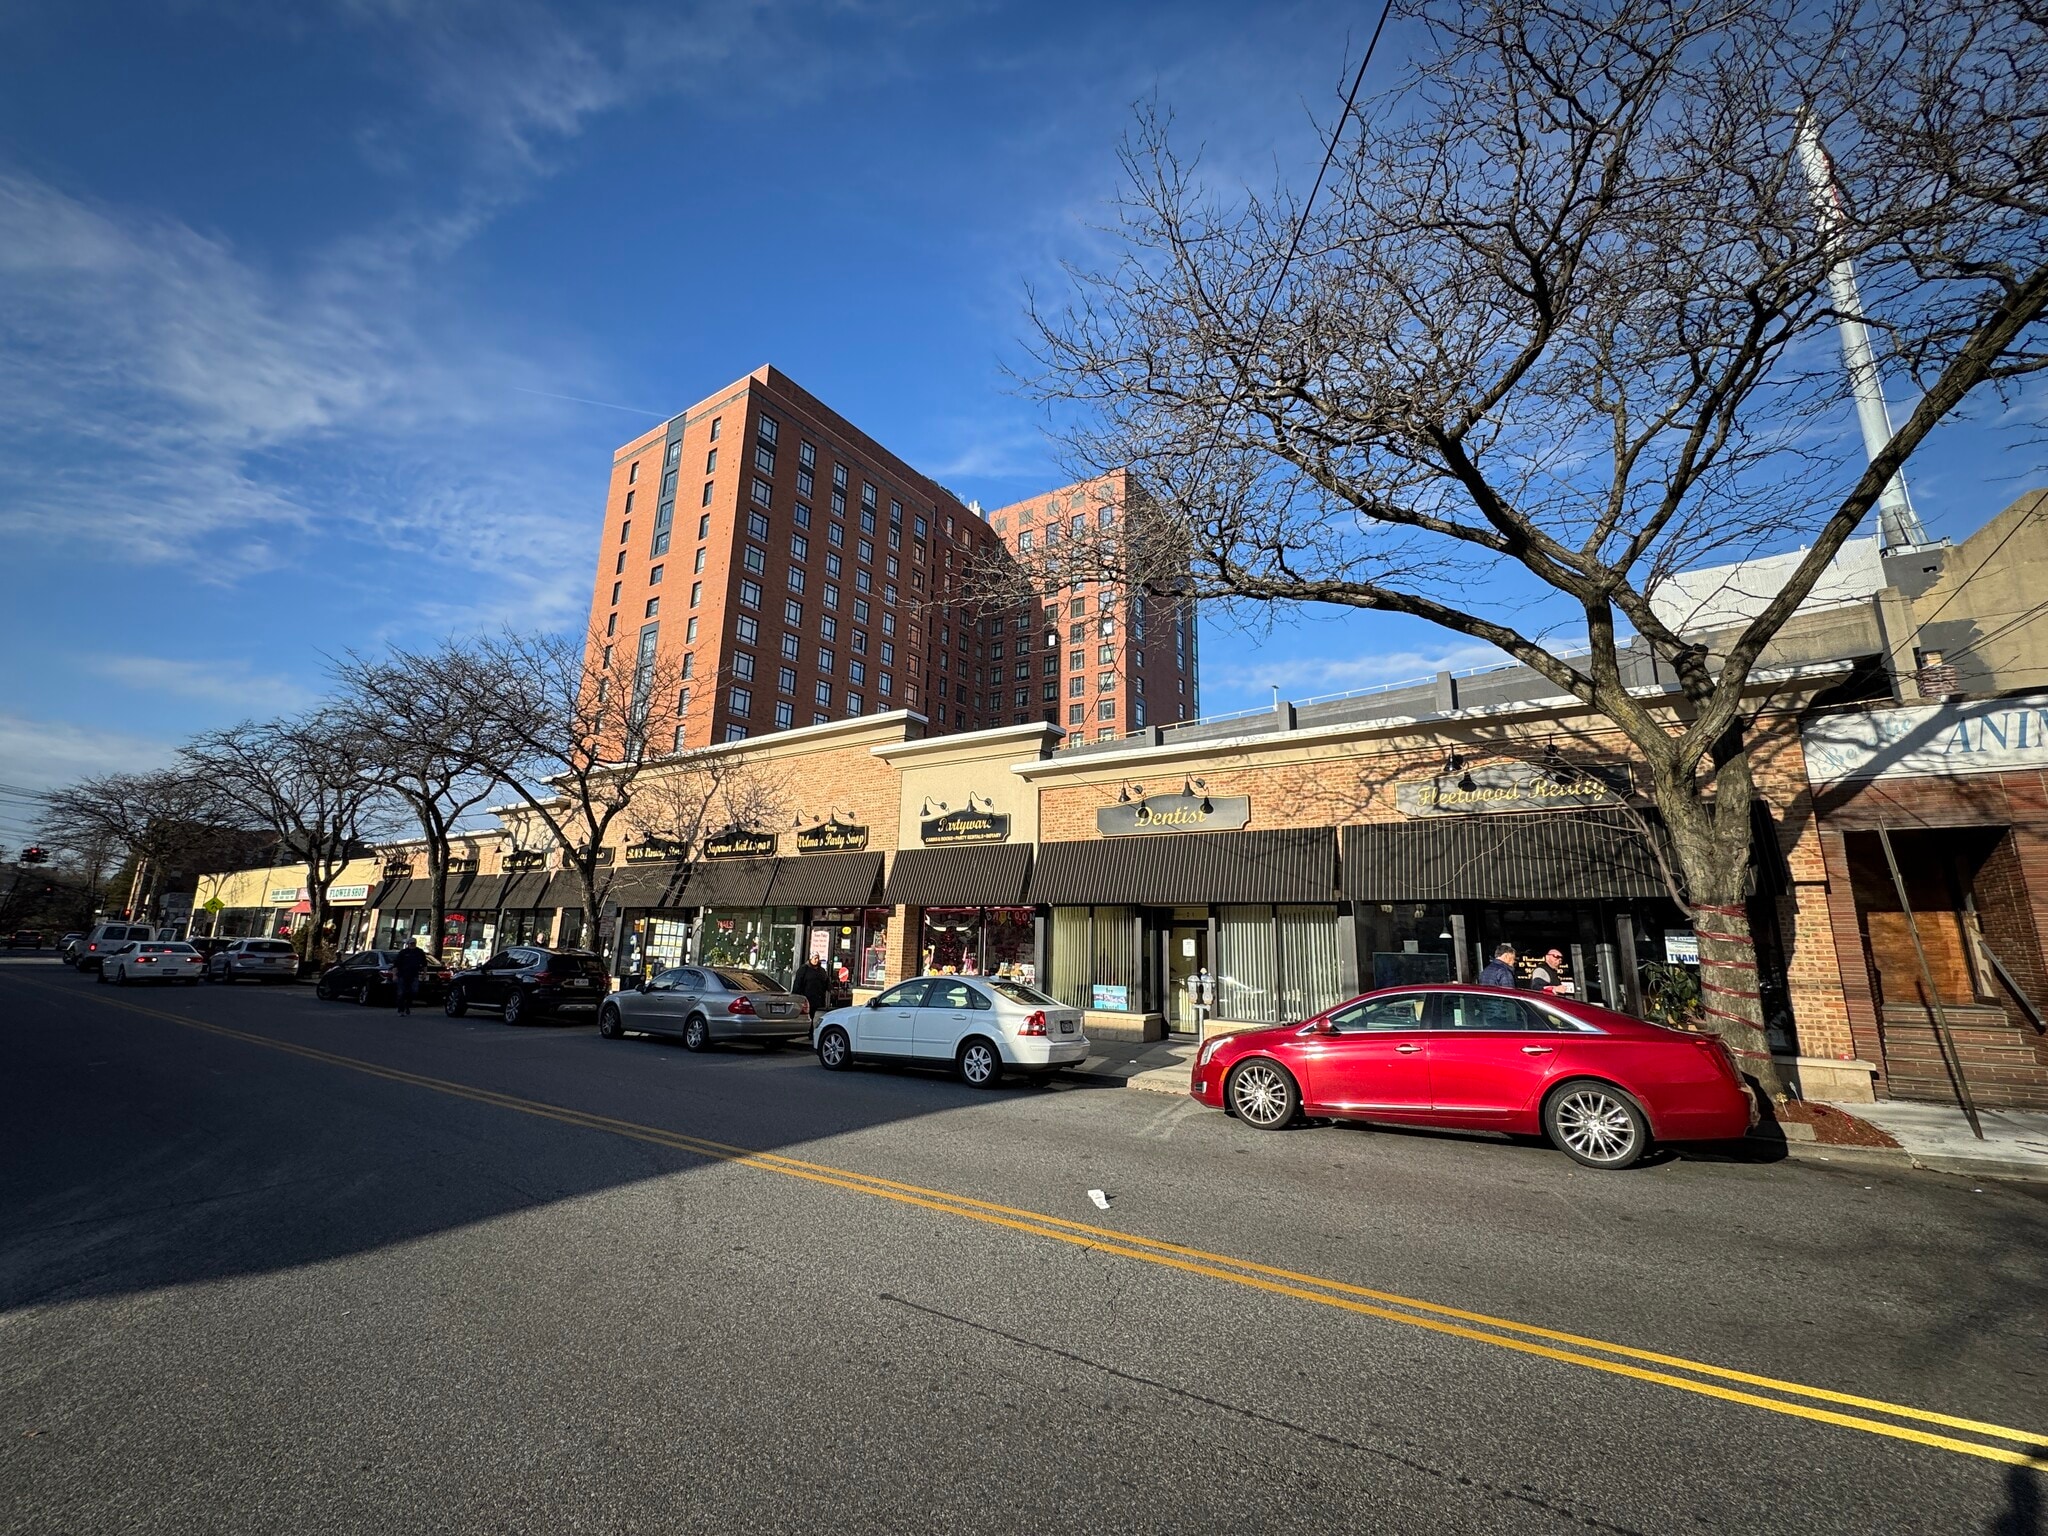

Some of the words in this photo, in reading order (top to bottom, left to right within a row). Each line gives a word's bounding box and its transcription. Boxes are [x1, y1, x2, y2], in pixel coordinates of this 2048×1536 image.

[1417, 781, 1520, 807] Fleetwood
[1528, 775, 1608, 801] Realty
[1134, 806, 1207, 827] Dentist
[937, 817, 992, 834] Partyware
[732, 839, 749, 852] Nail
[824, 832, 845, 849] Party
[846, 831, 864, 848] Shop
[328, 888, 351, 898] FLOWER
[351, 887, 366, 897] SHOP
[985, 910, 1036, 922] BALOON
